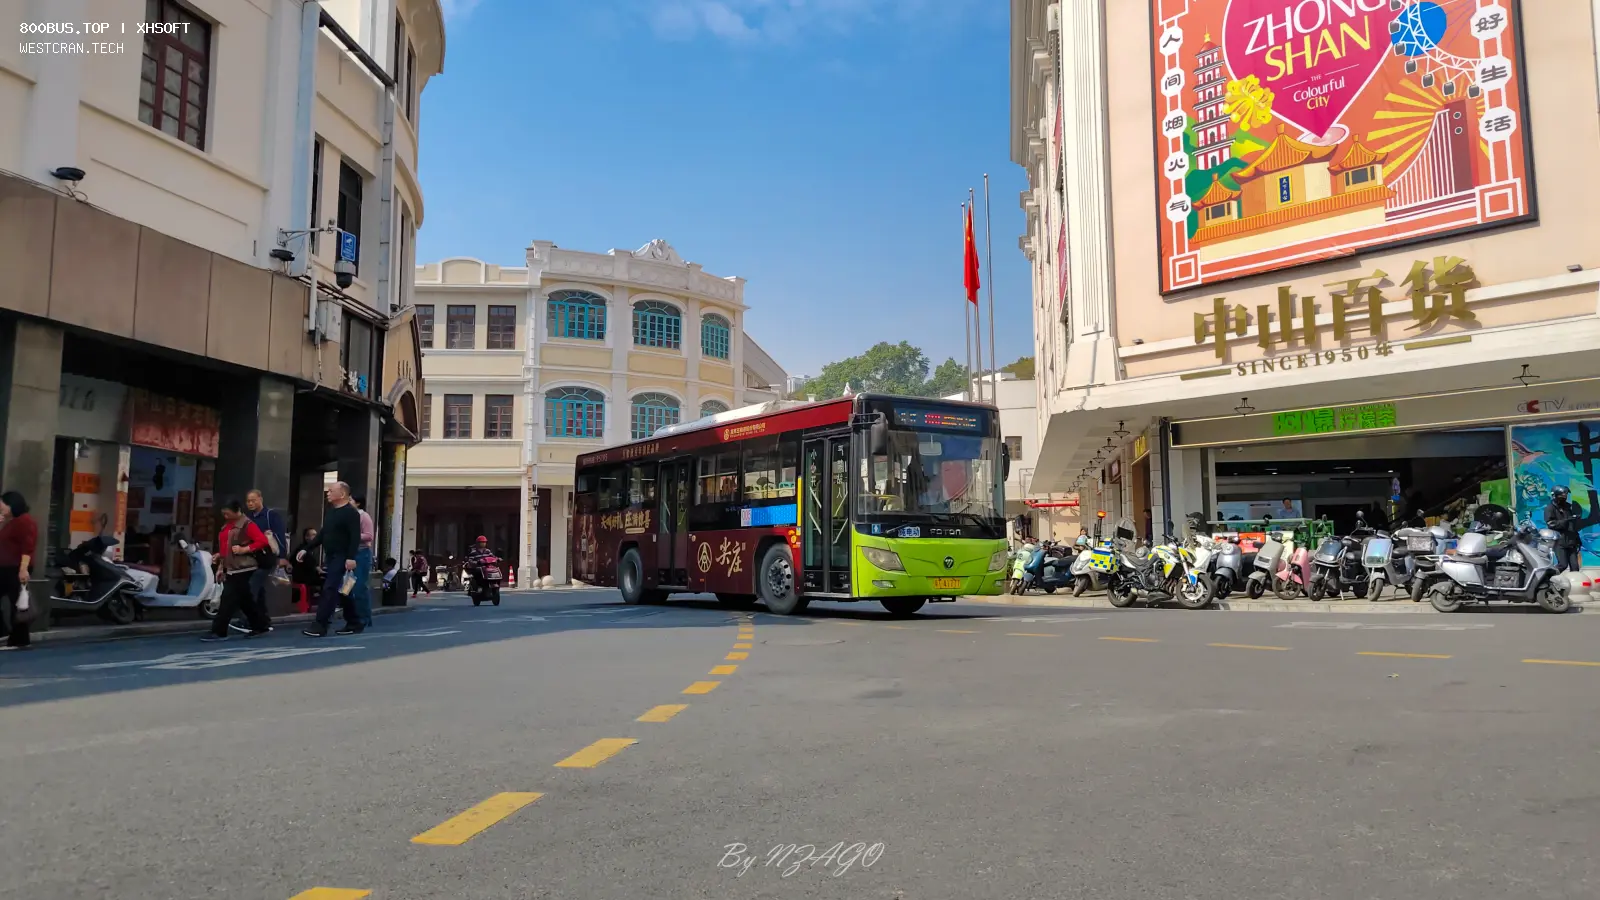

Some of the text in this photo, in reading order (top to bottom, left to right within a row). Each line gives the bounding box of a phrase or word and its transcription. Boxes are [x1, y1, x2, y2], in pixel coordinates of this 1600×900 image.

[1264, 16, 1372, 82] SHAN
[1292, 76, 1346, 104] Colourful
[1310, 73, 1322, 82] THE
[1475, 12, 1513, 134] 好生活
[1306, 94, 1331, 112] City
[1161, 33, 1192, 213] 人间烟火气
[1193, 255, 1476, 359] 中山百货
[1517, 398, 1565, 413] CCTV
[930, 528, 962, 536] FOTON
[716, 537, 743, 578] 尖庄
